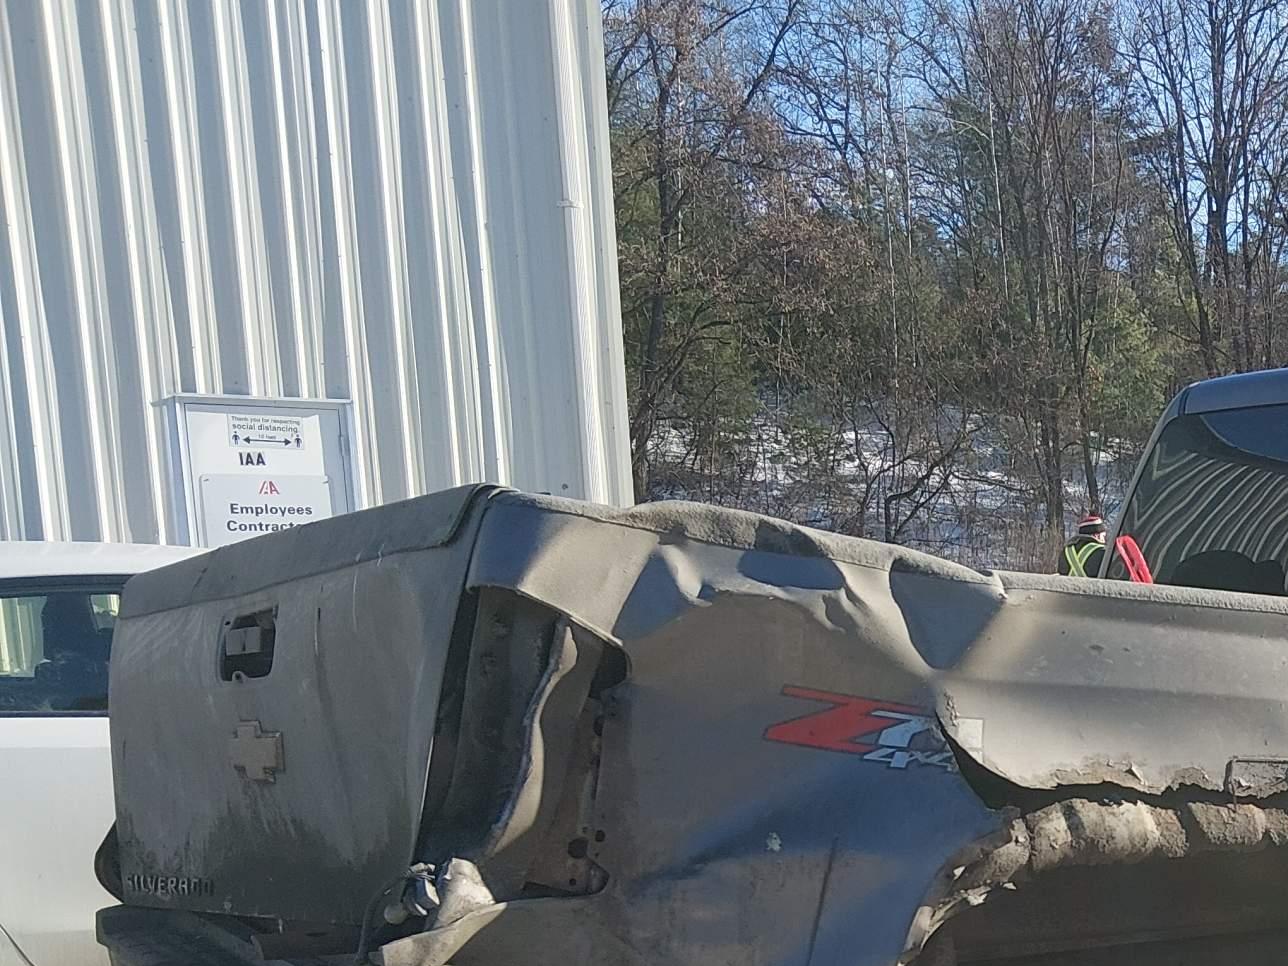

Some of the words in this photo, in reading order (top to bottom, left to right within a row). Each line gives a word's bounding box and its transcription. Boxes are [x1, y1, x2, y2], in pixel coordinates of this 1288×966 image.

[232, 422, 256, 431] social
[257, 424, 298, 433] distancing
[239, 452, 266, 466] IAA
[229, 502, 313, 517] Employees
[125, 873, 213, 896] SILVERADO
